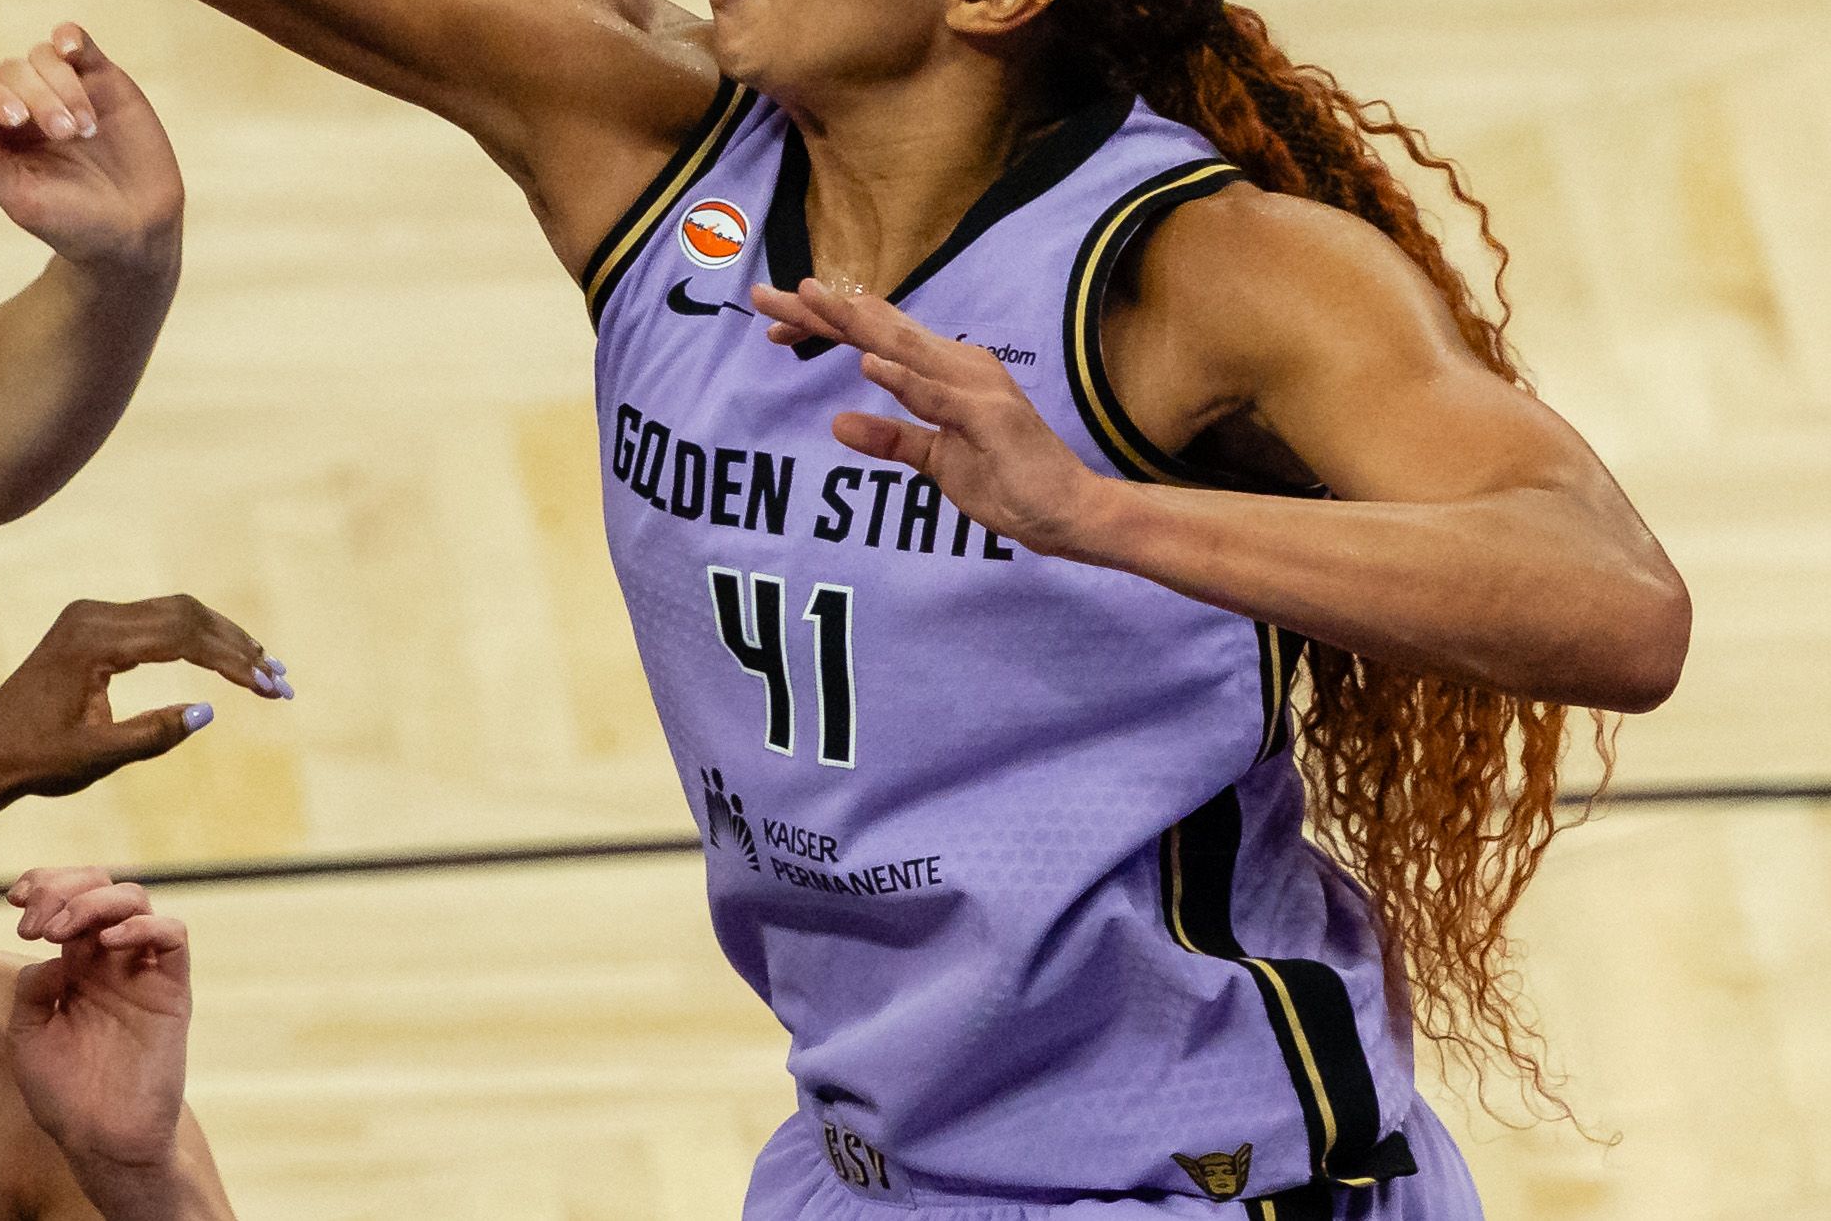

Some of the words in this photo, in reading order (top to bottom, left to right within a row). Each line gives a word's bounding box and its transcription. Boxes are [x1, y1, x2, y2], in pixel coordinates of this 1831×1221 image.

[706, 565, 857, 770] 41
[762, 817, 839, 863] KAISER
[770, 855, 943, 896] PERMANENTE
